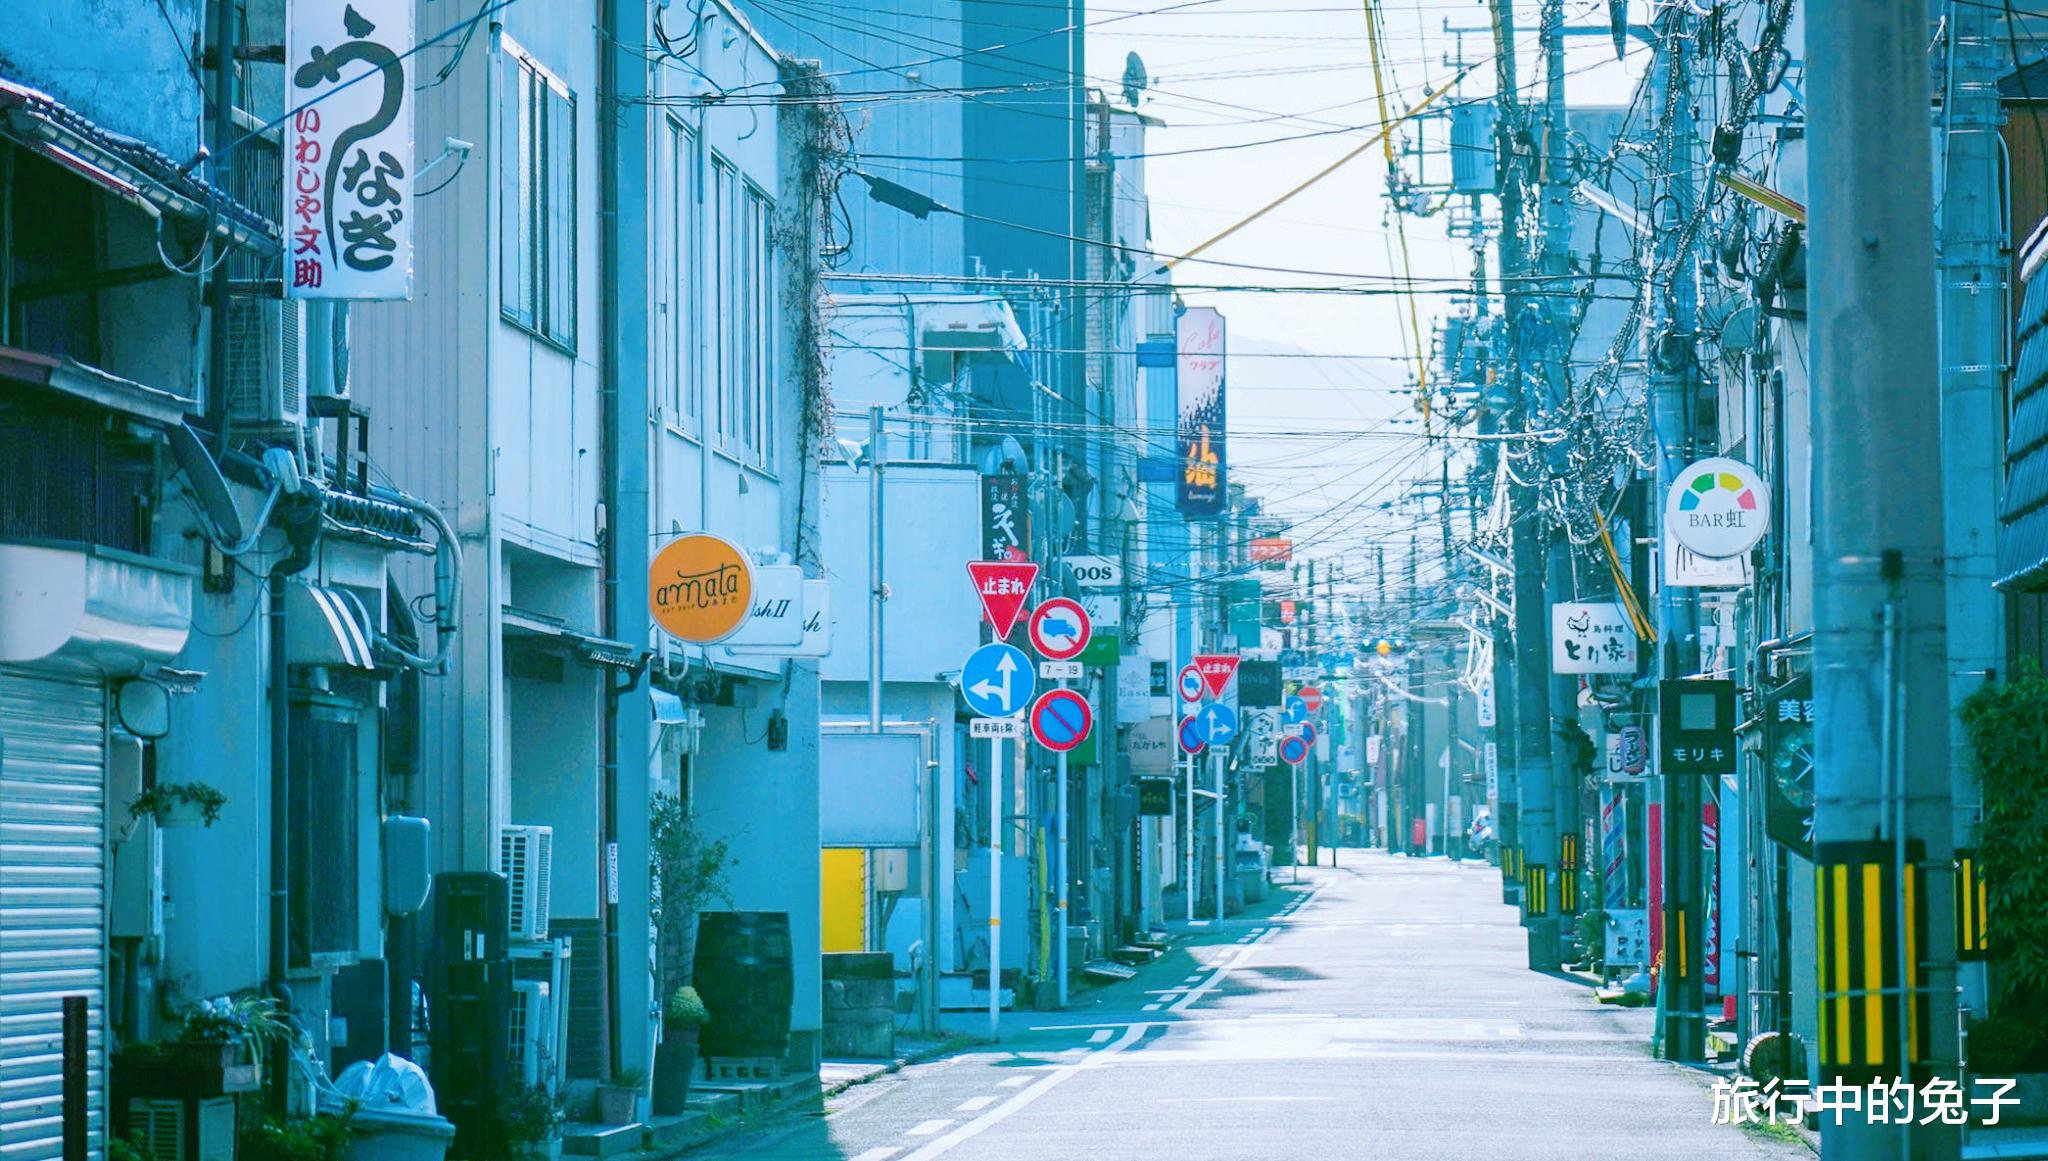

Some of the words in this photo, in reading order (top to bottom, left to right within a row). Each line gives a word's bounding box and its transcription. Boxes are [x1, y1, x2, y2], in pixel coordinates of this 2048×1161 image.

[294, 2, 405, 272] うなぎ
[293, 107, 322, 289] いわしや文助
[657, 562, 741, 608] amata
[982, 577, 1025, 595] 止まれ
[1565, 636, 1626, 665] とり家
[1203, 663, 1232, 674] 止まれ
[1673, 747, 1725, 762] モリキ
